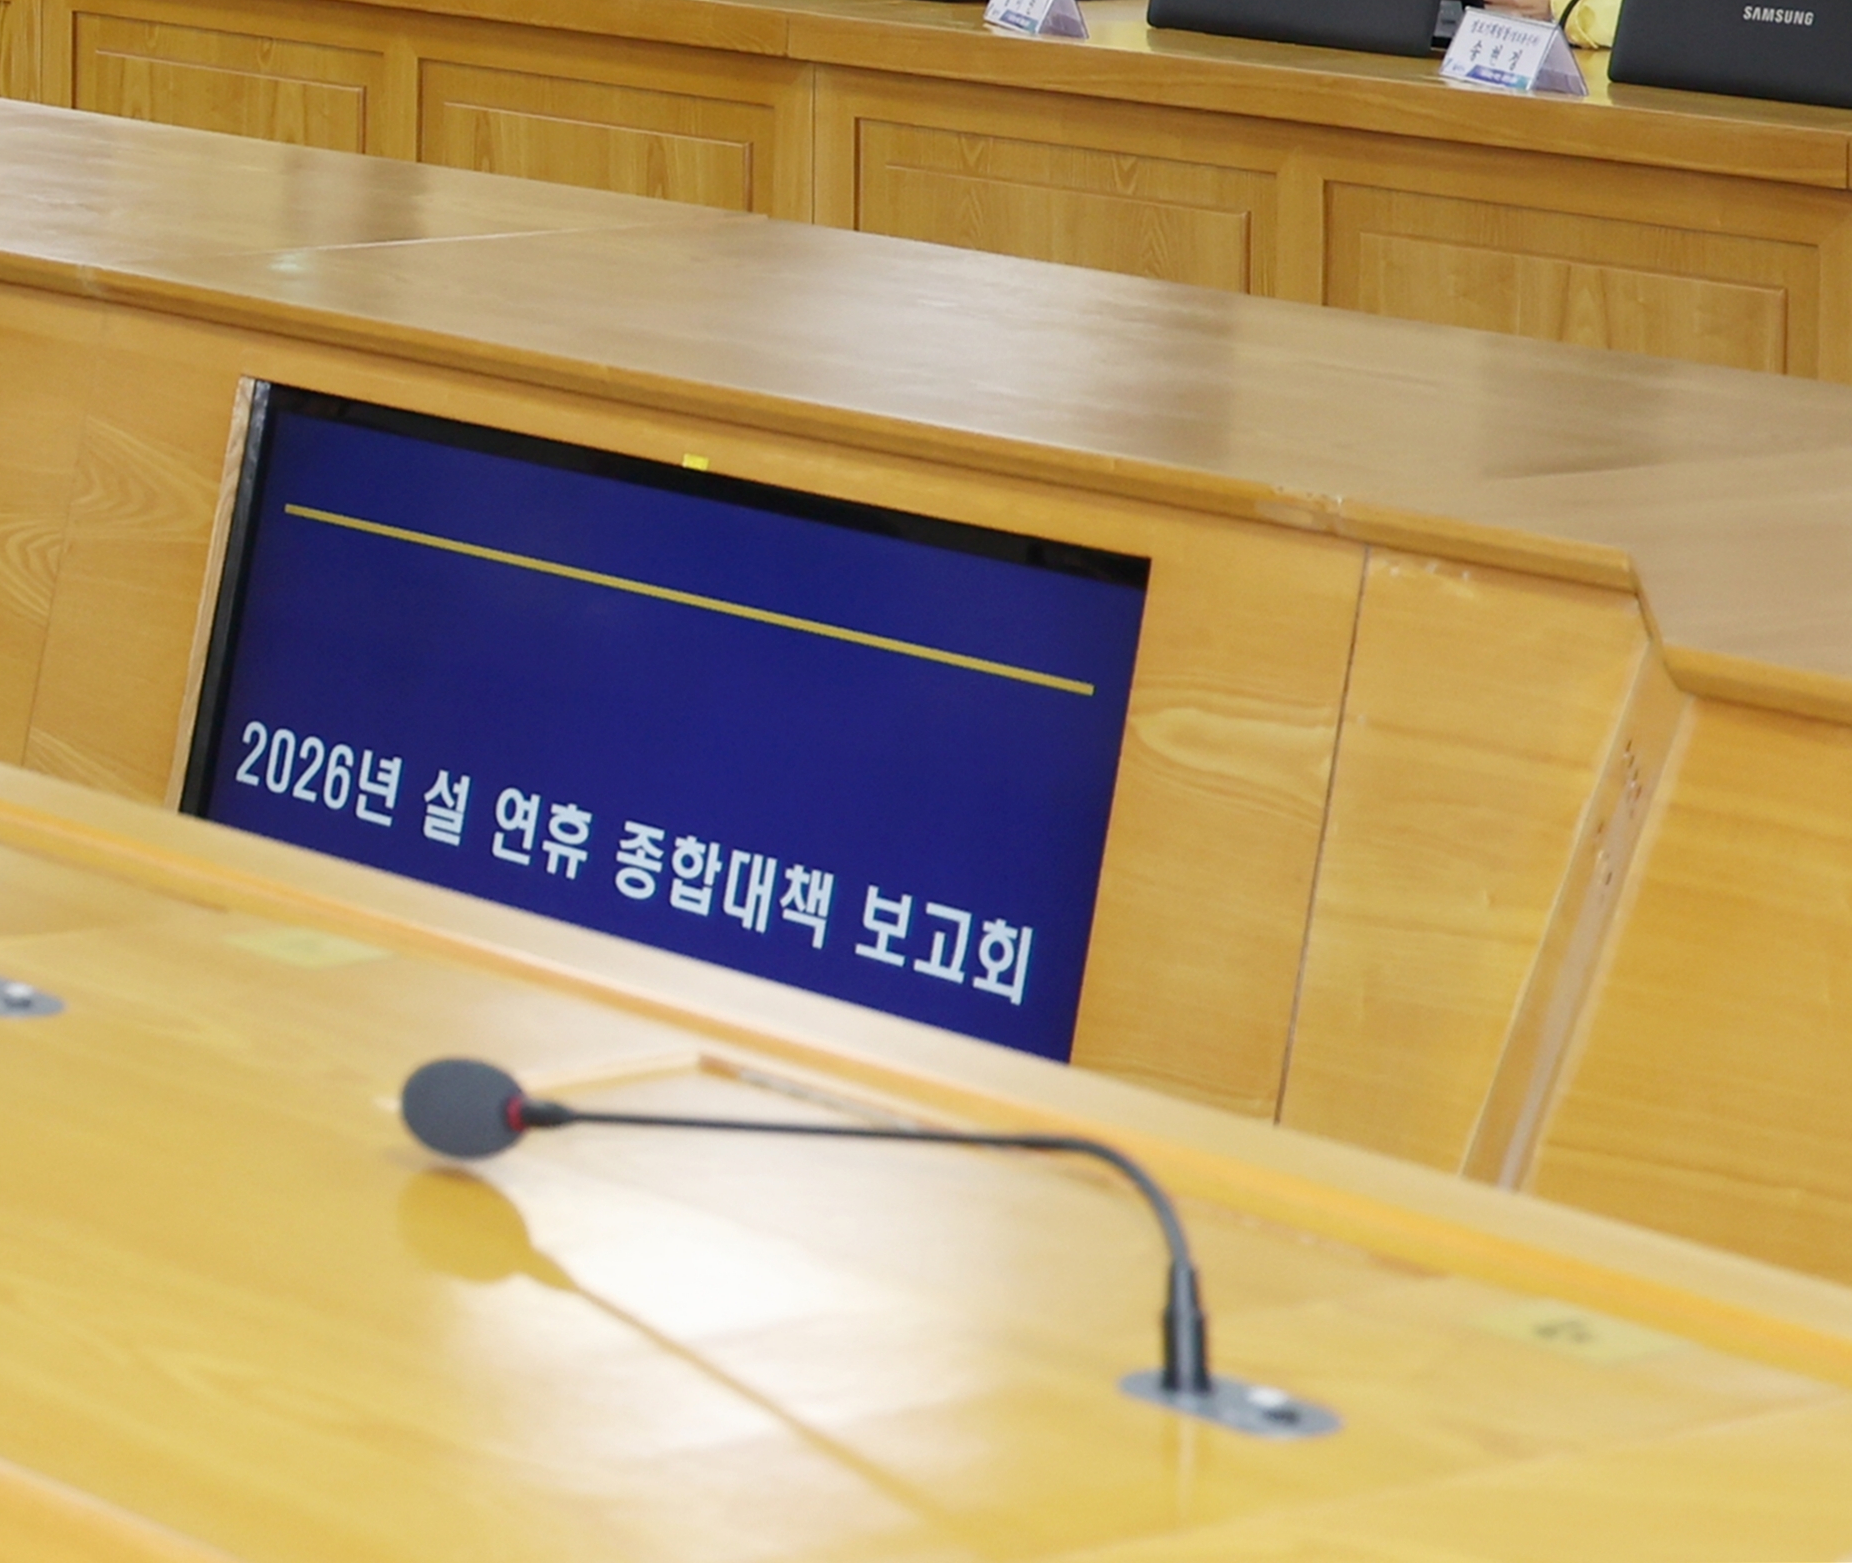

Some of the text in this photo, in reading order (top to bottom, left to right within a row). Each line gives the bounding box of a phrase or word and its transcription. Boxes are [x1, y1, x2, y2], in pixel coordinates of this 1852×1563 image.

[1741, 4, 1815, 27] SAMSUNG
[234, 720, 1034, 1006] 2026년 설 연휴 종합대책 보고회
